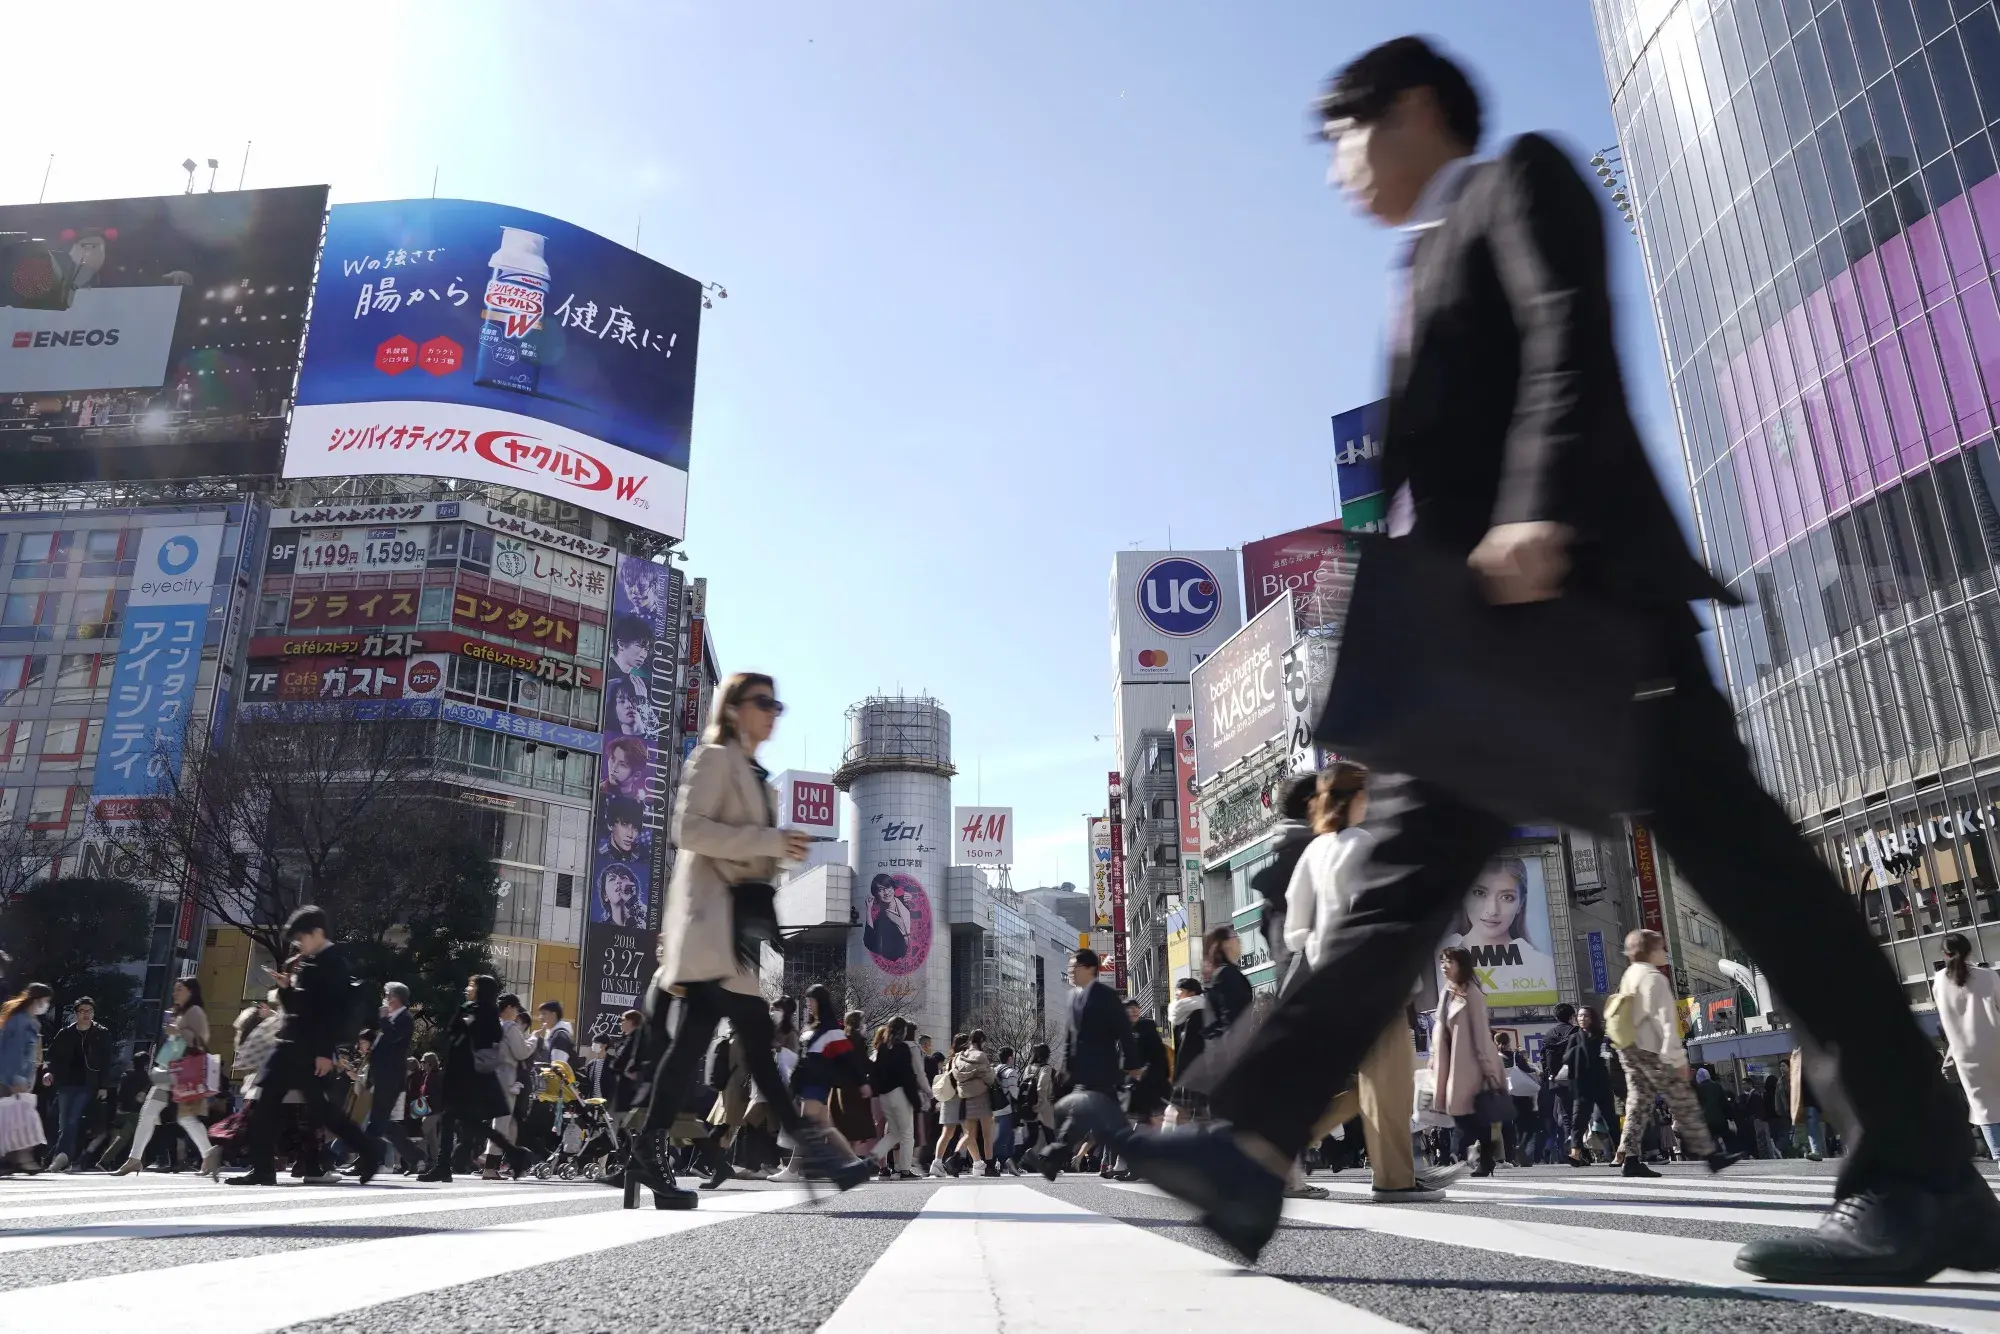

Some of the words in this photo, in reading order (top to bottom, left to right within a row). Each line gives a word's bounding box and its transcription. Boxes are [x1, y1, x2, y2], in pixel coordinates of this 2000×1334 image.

[344, 248, 445, 277] Wの強さで
[488, 282, 543, 302] シンバイオティクス
[497, 295, 534, 312] ヤクルト
[353, 276, 469, 320] 腸から
[554, 293, 677, 358] 健康に!
[507, 312, 542, 337] W
[33, 329, 120, 347] ENEOS
[328, 423, 471, 453] シンバイオティクス
[504, 440, 591, 482] ヤクルト
[616, 476, 648, 502] W
[290, 505, 425, 523] しゃぶしゃぶバイキング
[438, 505, 458, 516] 寿司
[487, 510, 610, 559] しゃぶしゃぶバイキング
[272, 544, 296, 560] 9F
[302, 543, 359, 570] 1,199円
[366, 541, 426, 567] 1,599円
[141, 578, 203, 597] eyecity
[534, 554, 605, 595] しゃぶ葉
[1262, 559, 1329, 597] Bioré
[668, 574, 680, 609] BULLET
[293, 593, 415, 620] プライス
[454, 593, 573, 643] コンタクト
[666, 613, 678, 642] TRAIN
[362, 633, 423, 657] ガスト
[249, 674, 278, 691] 7F
[284, 671, 318, 686] Café
[320, 666, 397, 698] ガスト
[412, 674, 437, 684] ガスト
[537, 657, 591, 688] ガスト
[1210, 670, 1232, 701] back
[1232, 642, 1271, 683] number
[110, 621, 165, 778] アイシティ
[146, 620, 196, 778] コンタクトの
[650, 640, 675, 742] GOLDEN
[1213, 659, 1275, 738] MAGIC
[450, 704, 488, 723] AEON
[495, 713, 542, 738] 英会話
[545, 726, 599, 748] イーオン
[641, 745, 669, 832] EPOCH
[797, 786, 827, 804] UNI
[797, 804, 829, 822] QLO
[881, 821, 923, 842] ゼロ!
[961, 813, 1006, 843] H&M
[1842, 804, 1996, 869] STRBUCKS
[651, 846, 662, 878] SAITAMA
[916, 844, 936, 853] キュー
[889, 857, 923, 868] ゼロ学割
[650, 880, 660, 904] SUPER
[649, 907, 658, 931] ARENA
[602, 947, 645, 979] 3.27
[601, 978, 615, 992] ON
[616, 979, 642, 995] SALE
[1512, 976, 1547, 989] ROLA
